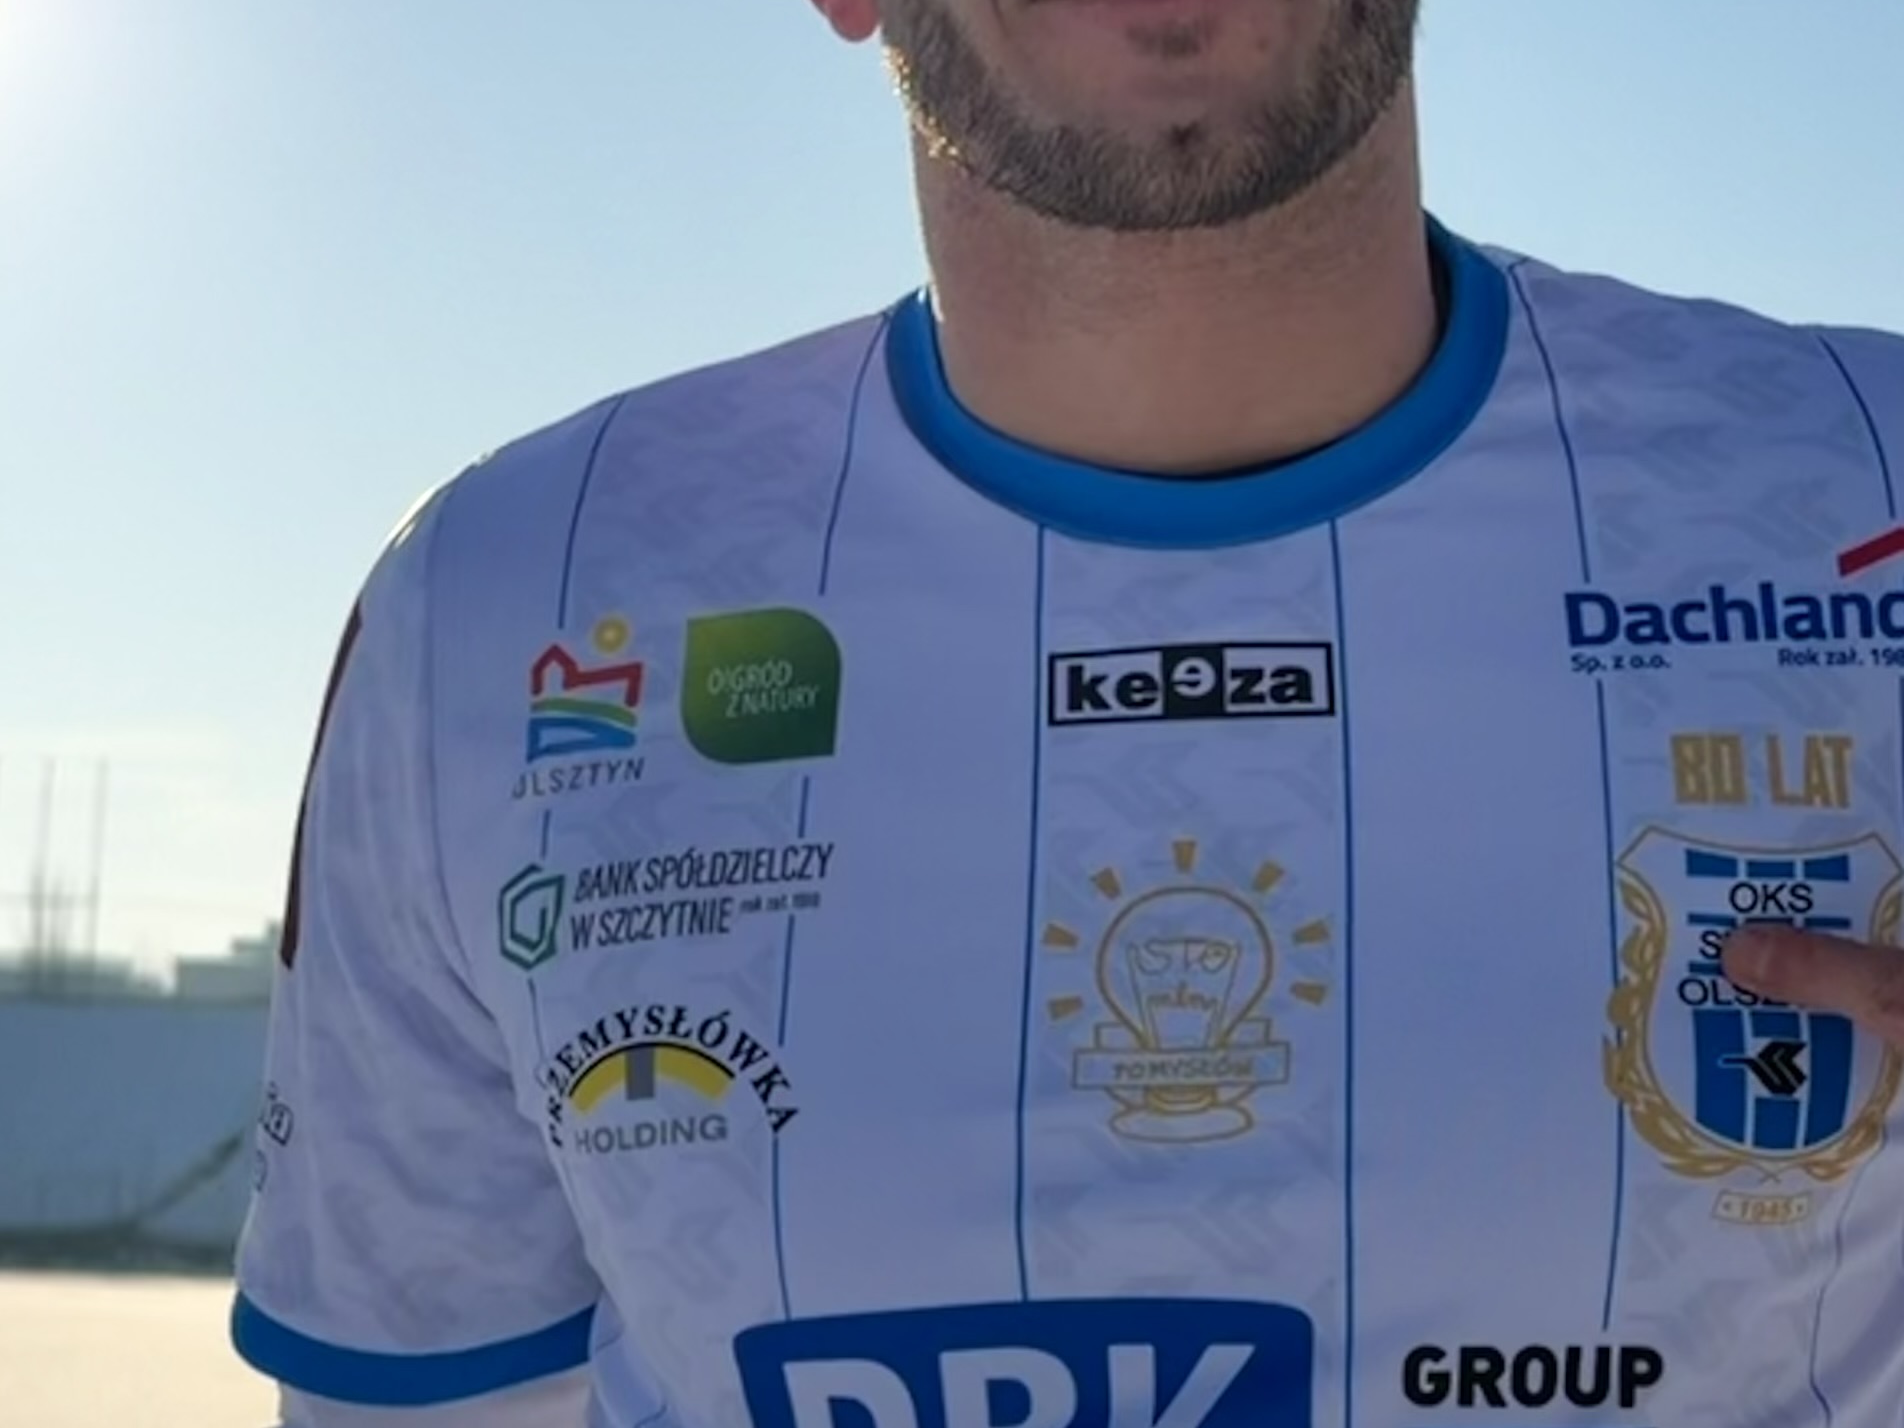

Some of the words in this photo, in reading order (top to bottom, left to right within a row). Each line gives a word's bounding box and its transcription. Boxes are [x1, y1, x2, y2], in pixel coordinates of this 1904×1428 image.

[1571, 654, 1607, 675] Sp.
[1612, 654, 1628, 670] z
[1630, 653, 1672, 671] o.o.
[1778, 648, 1820, 668] Rok
[1825, 647, 1863, 667] zał.
[1670, 732, 1748, 807] 80
[1764, 732, 1853, 809] LAT
[573, 859, 643, 903] BANK
[641, 842, 835, 890] SPÓŁDZIELCZY
[1729, 882, 1814, 914] OKS
[569, 912, 597, 952] W
[596, 896, 735, 947] SZCZYTNIE
[574, 1113, 729, 1155] HOLDING
[1401, 1344, 1665, 1408] GROUP
